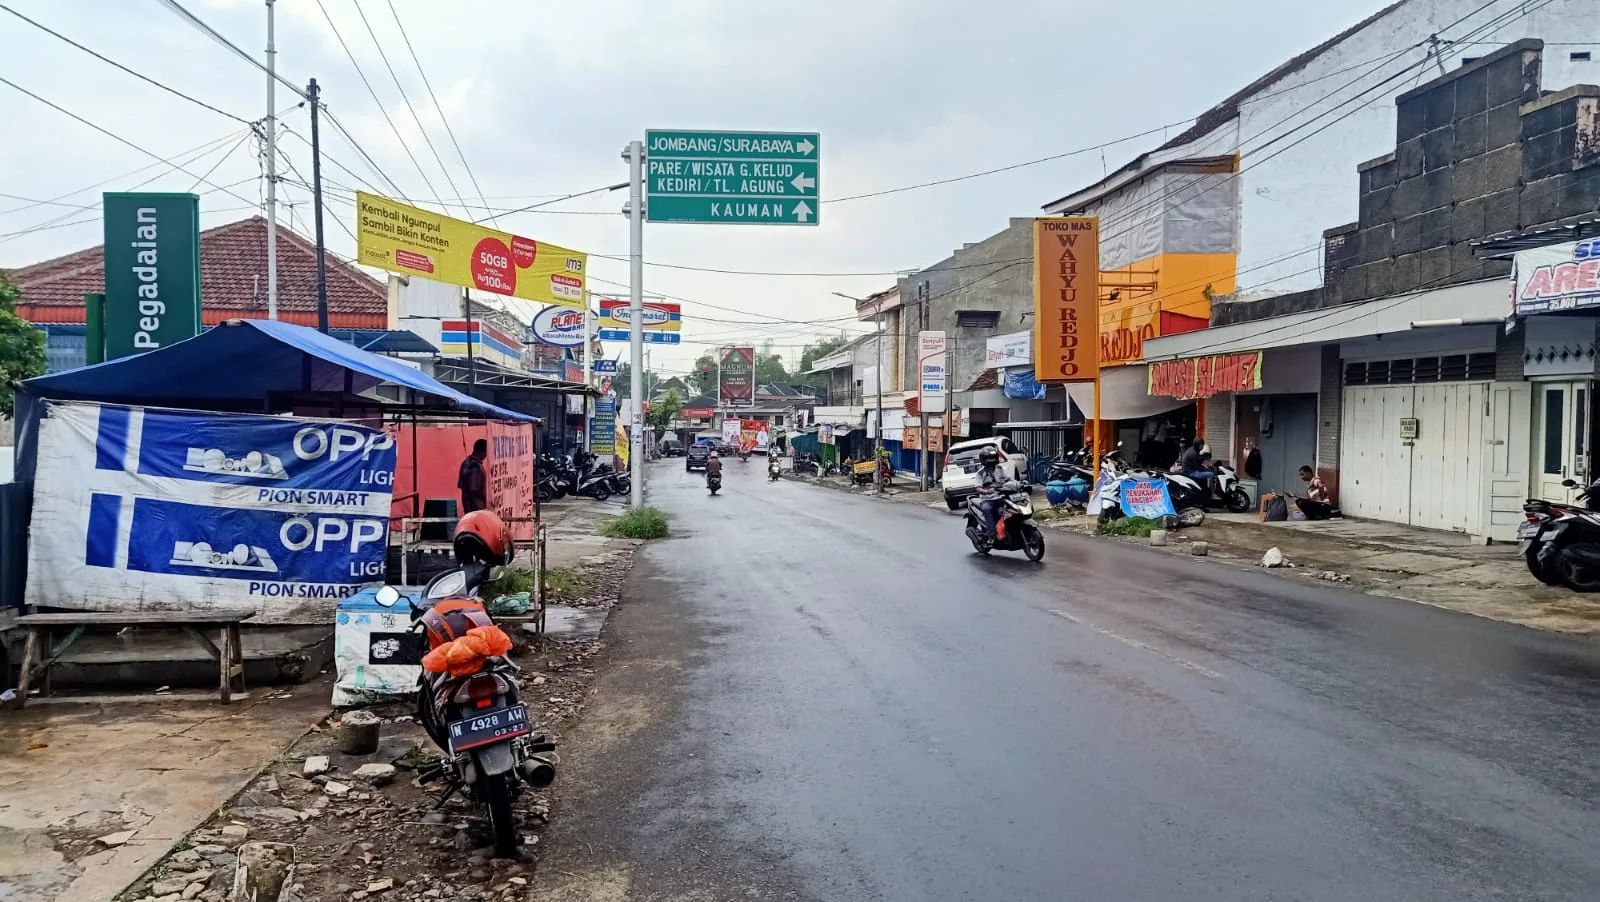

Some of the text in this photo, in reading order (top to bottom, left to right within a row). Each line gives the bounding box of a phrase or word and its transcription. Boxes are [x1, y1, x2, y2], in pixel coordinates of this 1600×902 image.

[650, 136, 794, 153] JOMBANG/SURABAYA
[740, 180, 784, 193] AGUNG
[362, 202, 440, 232] Kembali Ngumpul
[711, 203, 783, 217] KAUMAN
[363, 217, 394, 232] Sambil
[397, 226, 418, 239] Bikin
[420, 232, 449, 247] Konten
[1043, 222, 1092, 230] TOKO MAS
[480, 252, 507, 268] 50GB
[1056, 234, 1078, 302] WAHYU
[132, 208, 165, 348] Pegadaian
[615, 308, 666, 320] Inmaret
[1059, 308, 1078, 376] REDJO
[1152, 352, 1258, 398] BAKSO SLAMET
[293, 427, 397, 461] OPP
[258, 488, 369, 506] PION SMART
[280, 517, 390, 553] OPP
[250, 582, 361, 598] PION SMART
[454, 708, 522, 736] N 4928 AW
